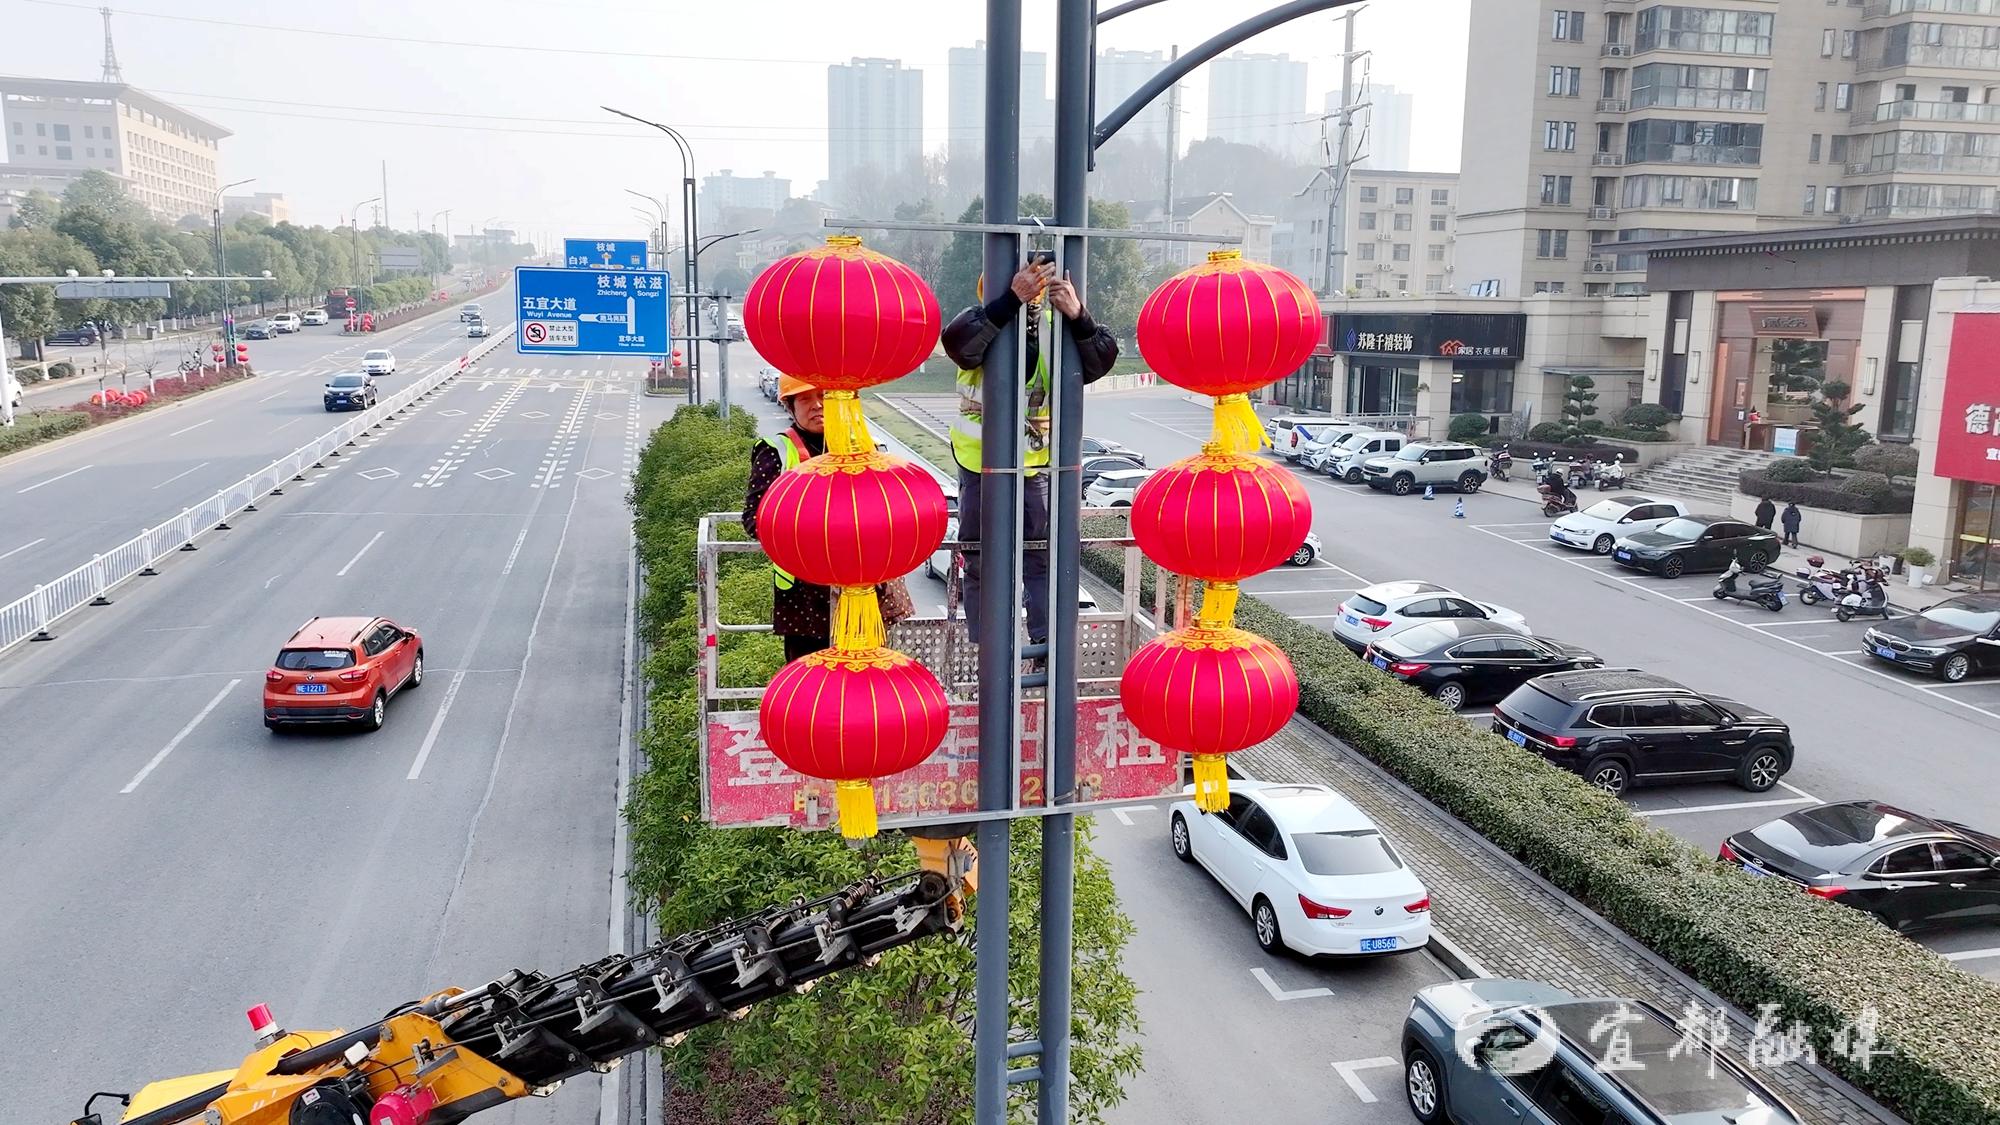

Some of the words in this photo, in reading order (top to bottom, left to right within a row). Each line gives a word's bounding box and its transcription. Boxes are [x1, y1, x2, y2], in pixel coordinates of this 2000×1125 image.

[596, 242, 616, 252] 枝城
[568, 256, 588, 266] 白洋
[597, 275, 627, 288] 枝城
[633, 275, 662, 289] 松滋
[597, 289, 627, 297] Zhicheng
[637, 290, 660, 298] Songzi
[522, 297, 577, 310] 五宜大道
[526, 311, 544, 319] Wuyi
[1357, 332, 1413, 352] 苏隆千禧装饰
[1965, 403, 2000, 436] 德
